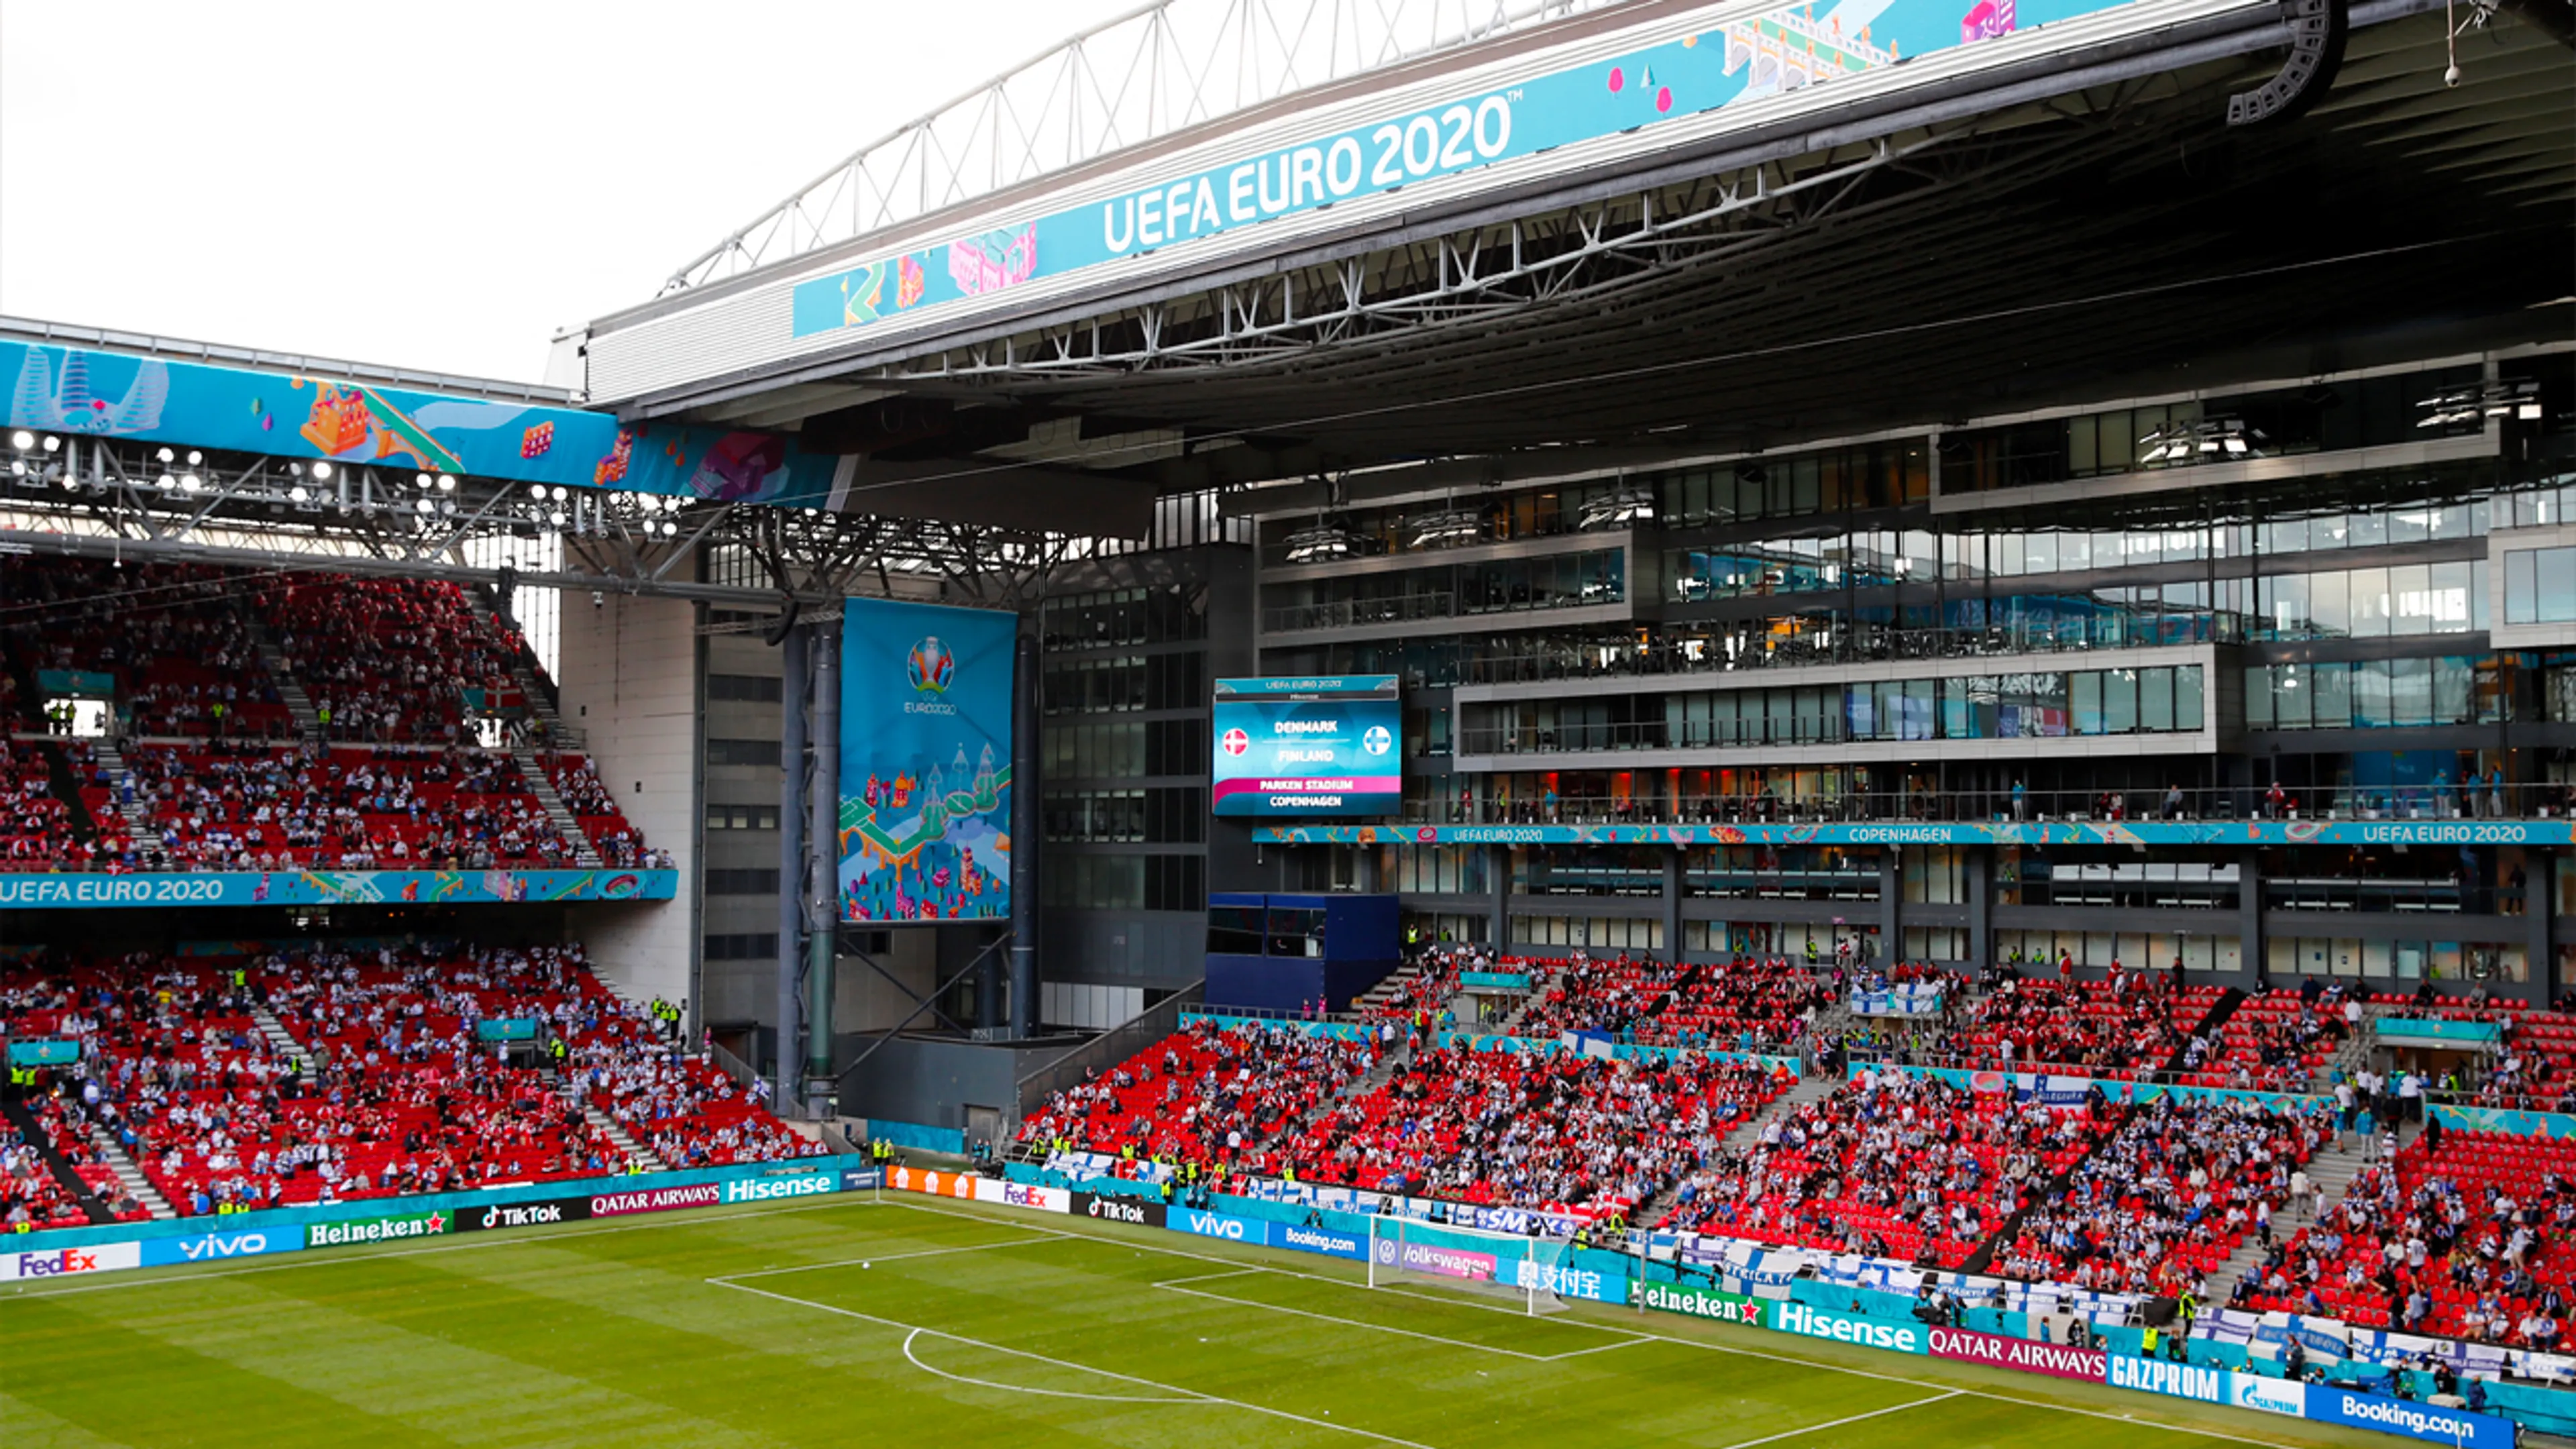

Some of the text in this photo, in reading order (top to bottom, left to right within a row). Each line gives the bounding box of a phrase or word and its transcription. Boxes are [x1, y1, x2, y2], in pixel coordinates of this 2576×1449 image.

[1104, 176, 1220, 253] UEFA
[1228, 137, 1362, 221] EURO
[1371, 96, 1511, 186] 2020
[1274, 721, 1338, 734] DENMARK
[1278, 751, 1334, 762] FINLAND
[1260, 780, 1353, 790] PARKEN STADIUM
[1269, 796, 1342, 806] COPENHAGEN
[1454, 828, 1543, 842] UEFA EURO 2020
[1849, 828, 1951, 842] COPENHAGEN
[2363, 825, 2526, 842] UEFA EURO 2020
[0, 879, 223, 902] UEFA EURO 2020
[591, 1185, 720, 1215] QATAR AIRWAYS
[728, 1176, 830, 1201] Hisense
[1005, 1183, 1046, 1207] FedEx
[502, 1205, 561, 1226] TikTok
[1103, 1199, 1144, 1223] TikTok
[310, 1218, 423, 1246] Heineken
[1189, 1212, 1243, 1238] vivo
[179, 1233, 266, 1259] vivo
[1285, 1227, 1356, 1252] Booking.com
[19, 1249, 97, 1277] FedEx
[1779, 1302, 1915, 1352] Hisense
[1929, 1330, 2106, 1378] QATAR AIRWAYS
[2112, 1354, 2218, 1401] GAZPROM
[2342, 1395, 2474, 1438] Booking.com
